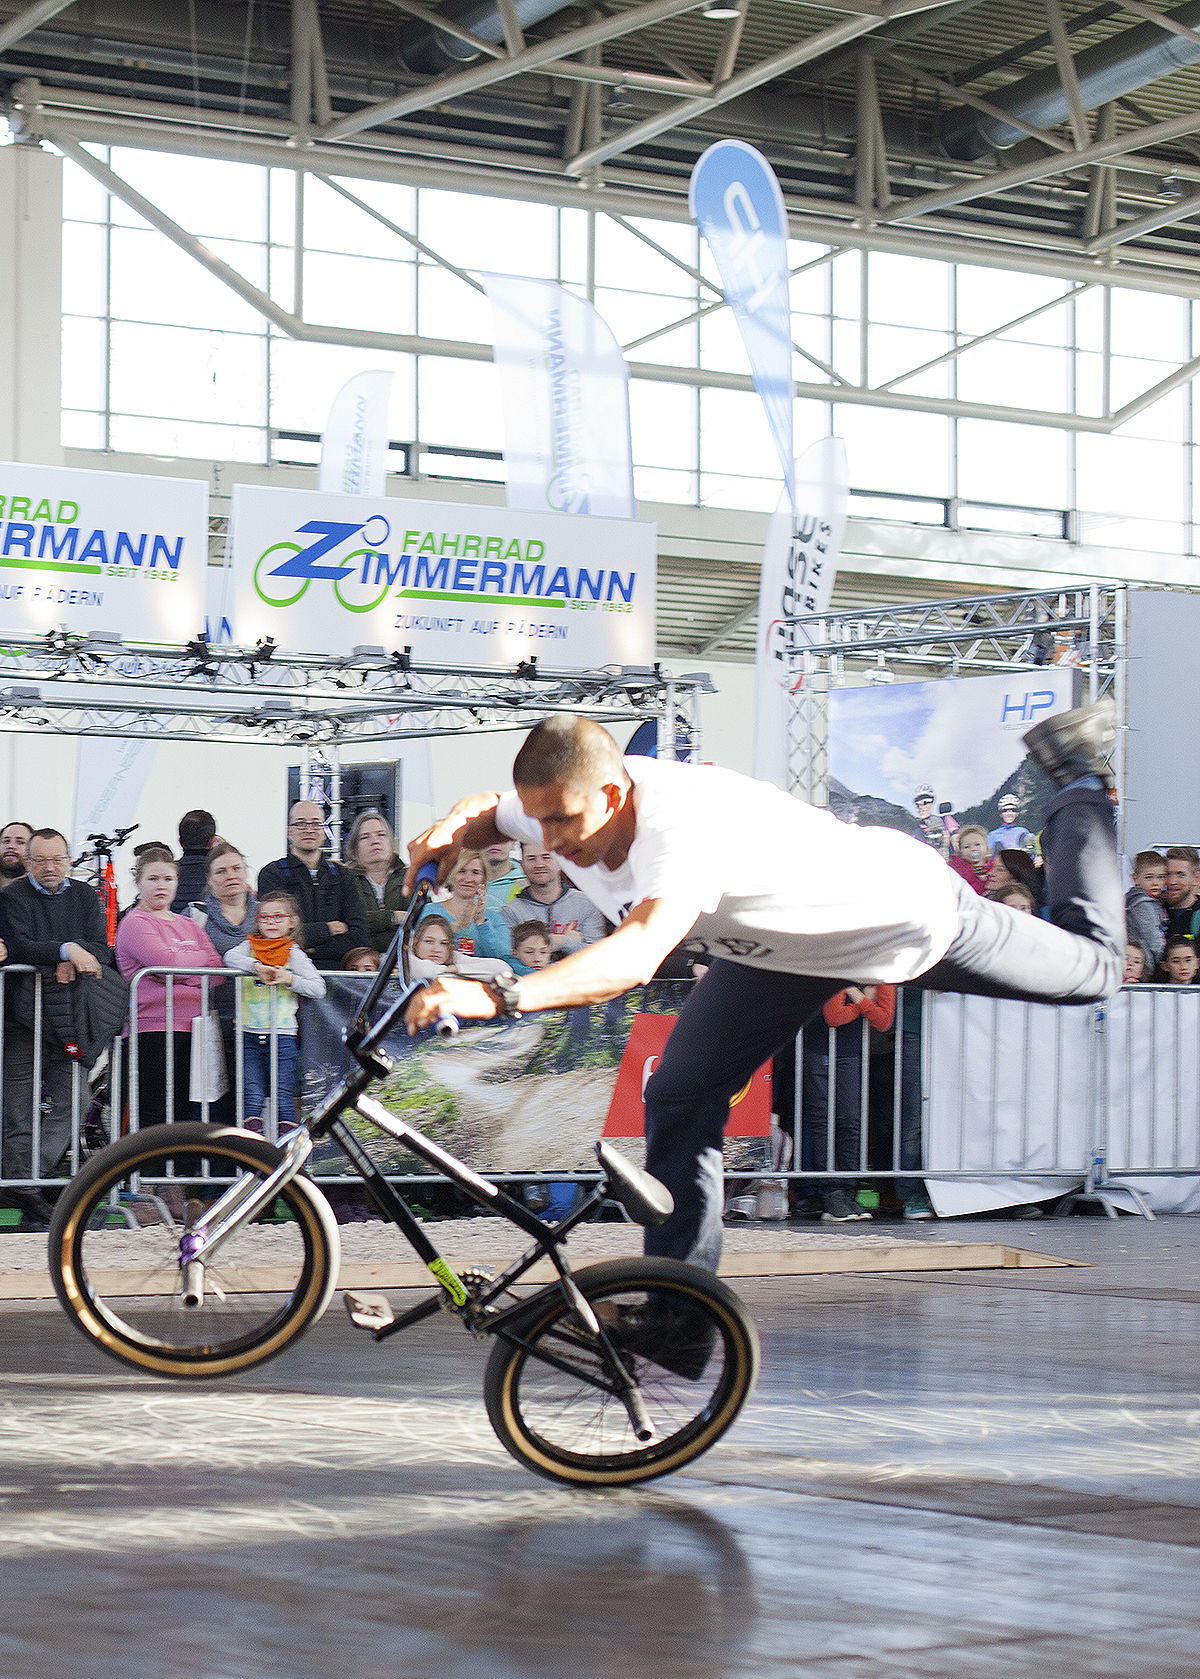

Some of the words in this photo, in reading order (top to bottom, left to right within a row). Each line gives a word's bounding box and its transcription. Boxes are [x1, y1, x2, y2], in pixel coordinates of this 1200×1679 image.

[402, 529, 546, 563] FAHRRAD
[105, 565, 139, 579] SEIT
[266, 519, 638, 603] ZIMMERMANN
[570, 599, 599, 612] SEIT
[394, 613, 464, 635] ZUKUNFT
[469, 619, 499, 636] AUF
[1001, 690, 1056, 723] HP
